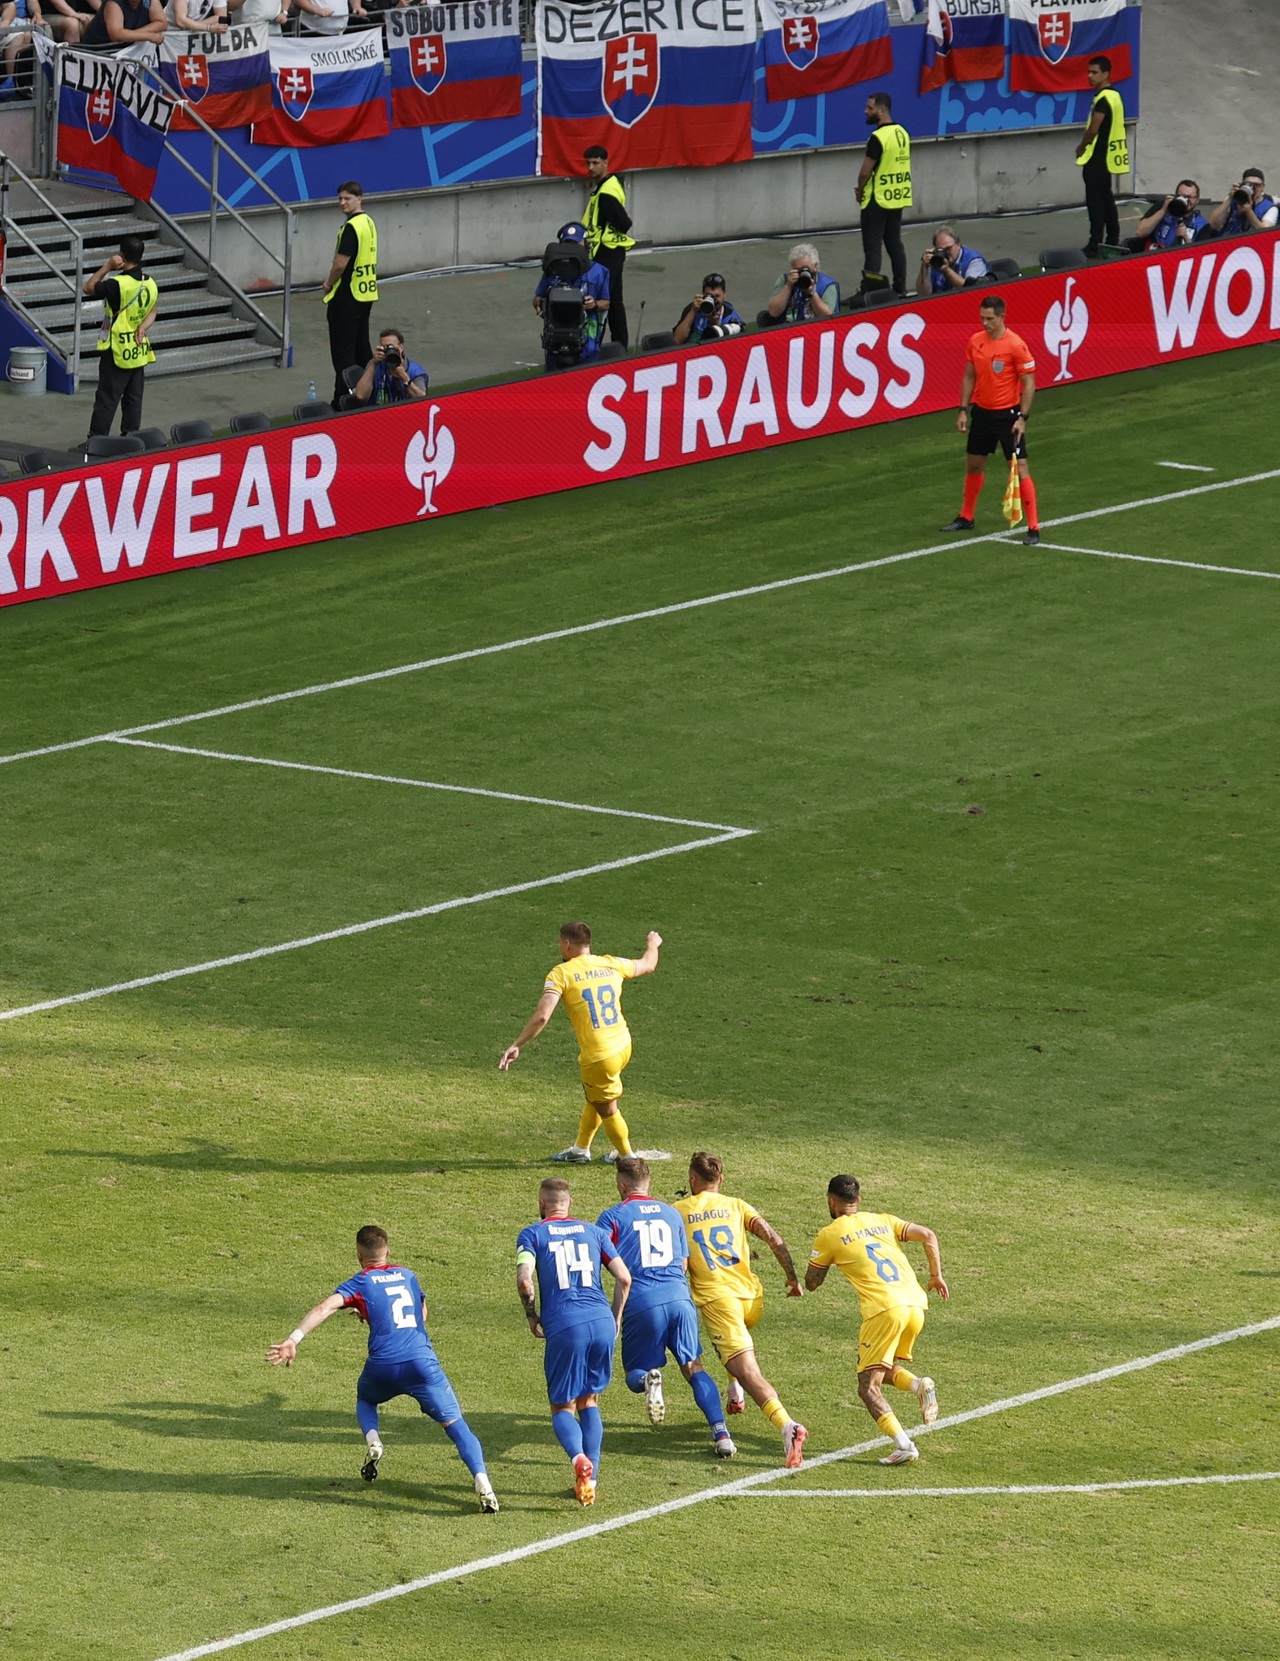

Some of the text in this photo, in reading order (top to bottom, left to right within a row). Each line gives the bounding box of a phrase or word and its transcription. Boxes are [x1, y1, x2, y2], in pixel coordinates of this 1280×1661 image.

[187, 26, 259, 55] FULDA
[543, 0, 746, 43] DEŽERICE
[310, 40, 378, 68] SMOLINSKÉ
[583, 312, 926, 473] STRAUSS
[585, 967, 615, 980] MARIN
[581, 984, 619, 1030] 18
[632, 1218, 674, 1268] 19
[692, 1225, 740, 1271] 19
[855, 1224, 890, 1240] MARIN
[548, 1239, 595, 1290] 14
[865, 1242, 900, 1283] 6
[384, 1285, 418, 1330] 2
